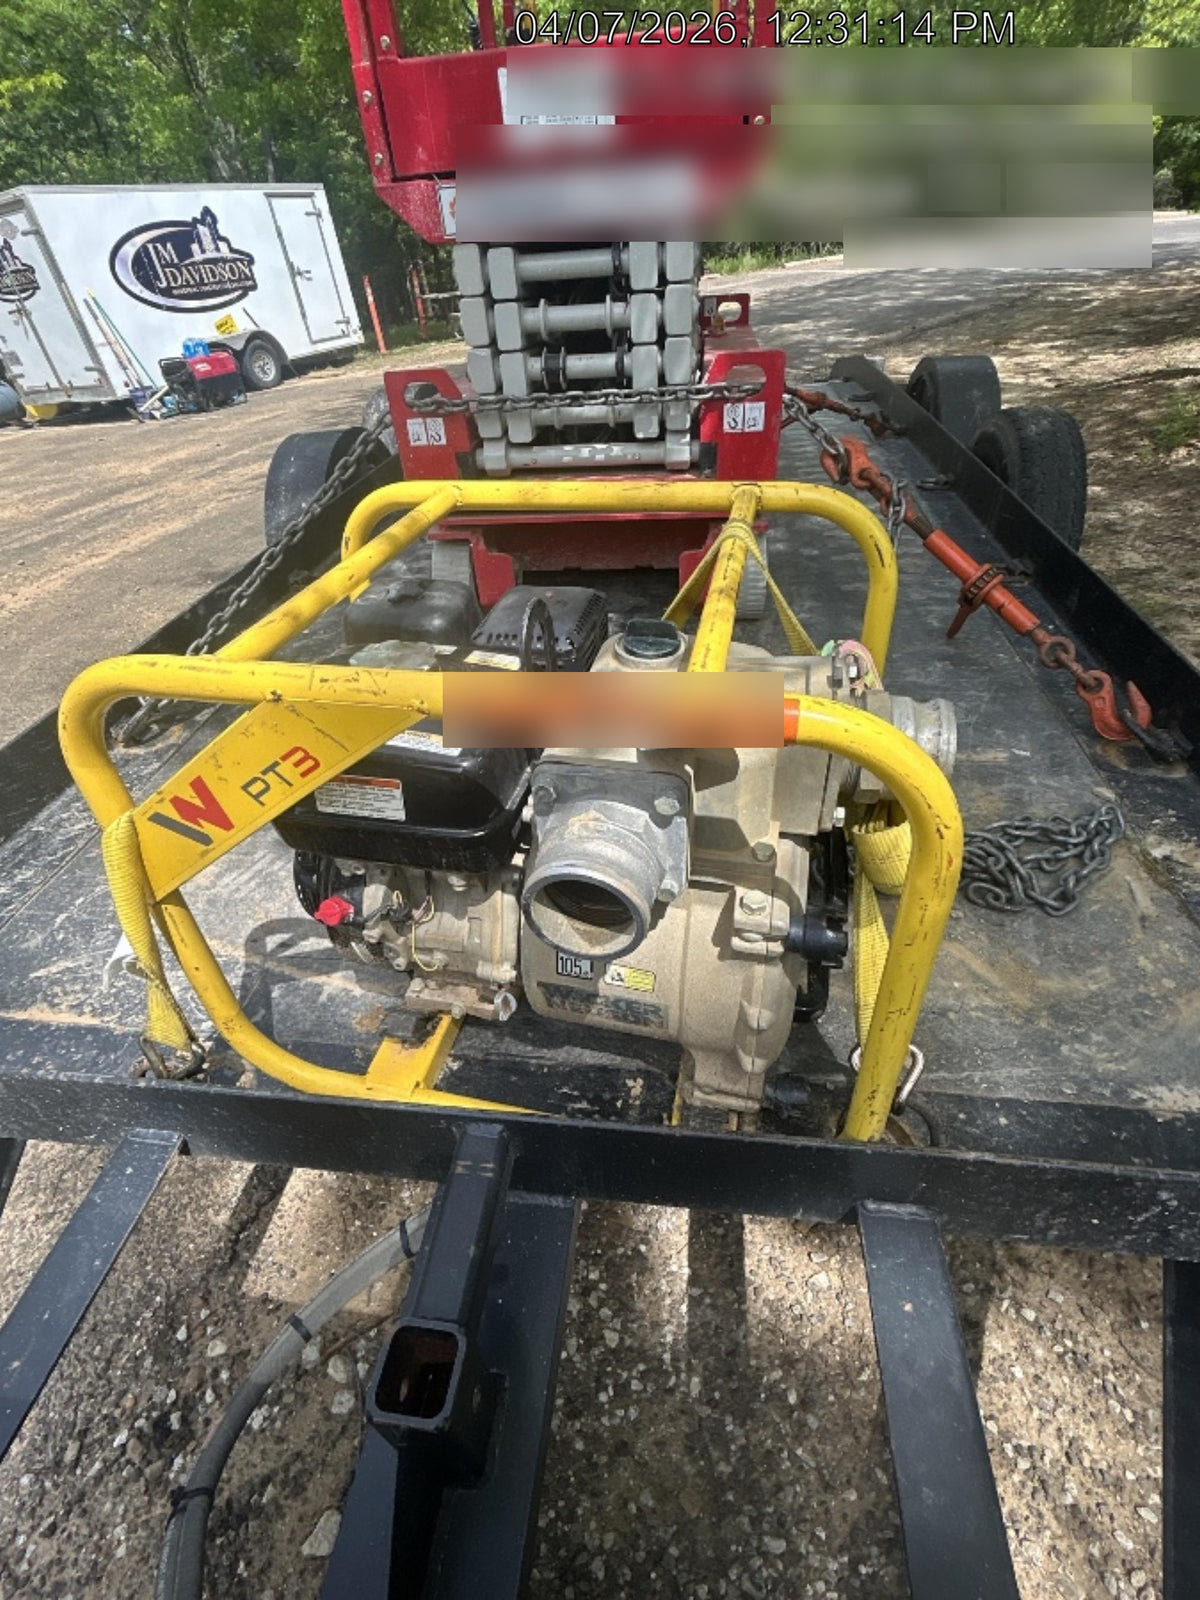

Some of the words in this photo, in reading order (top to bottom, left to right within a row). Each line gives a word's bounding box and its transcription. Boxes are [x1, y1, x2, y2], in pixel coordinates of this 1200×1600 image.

[164, 260, 252, 288] DAVIDSON
[240, 745, 321, 807] PT3
[559, 955, 583, 979] 105
